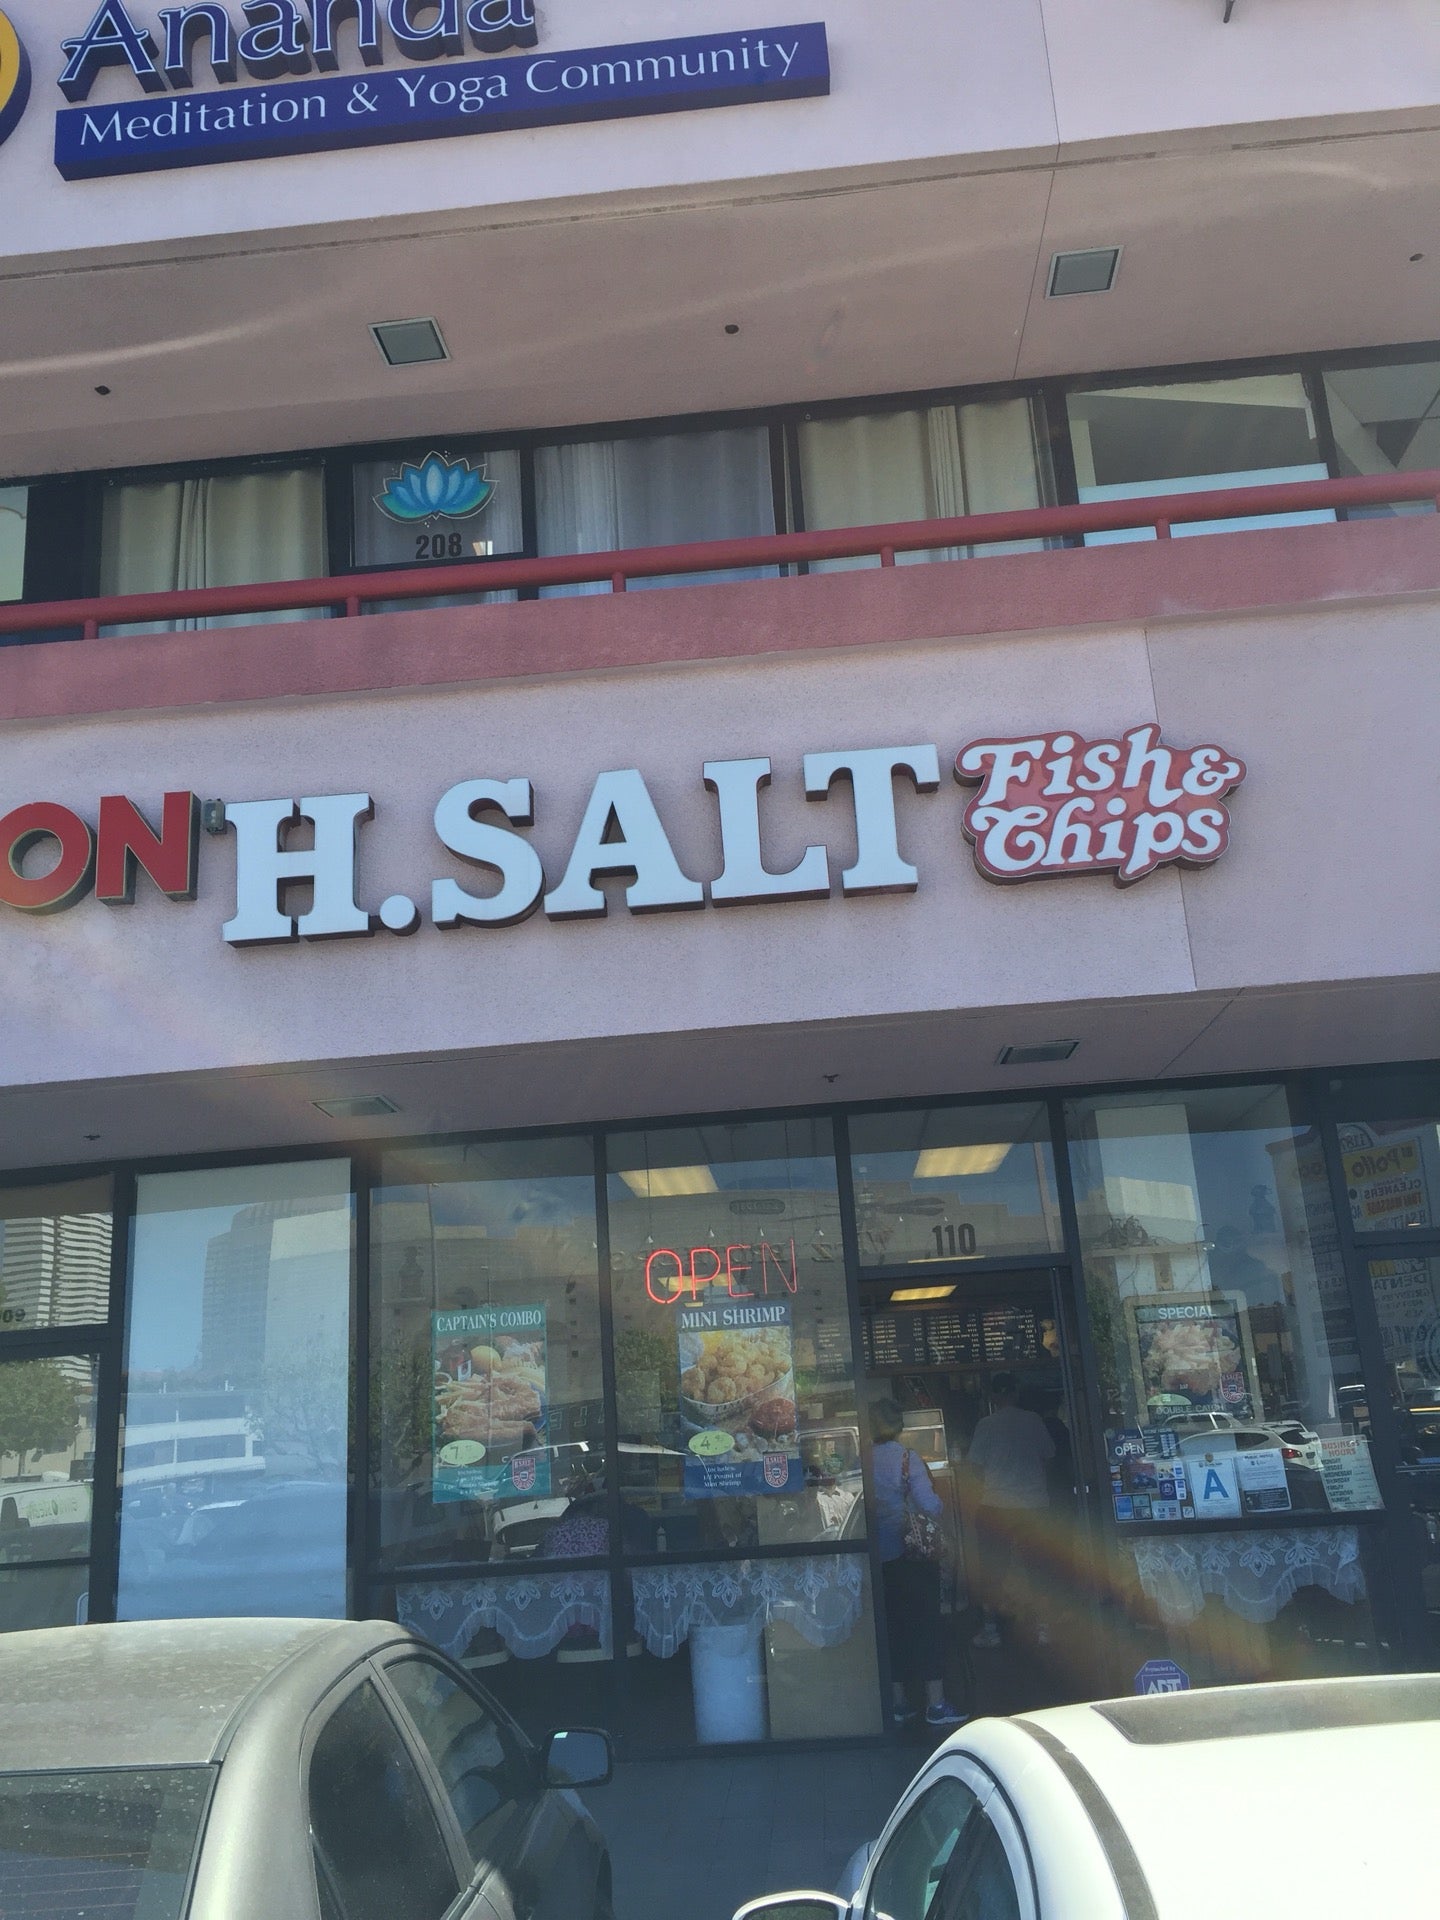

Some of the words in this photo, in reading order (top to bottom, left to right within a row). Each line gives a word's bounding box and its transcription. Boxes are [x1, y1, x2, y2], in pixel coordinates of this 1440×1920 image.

[58, 0, 536, 84] Ananda
[79, 92, 327, 146] Meditation
[347, 84, 380, 114] &
[396, 70, 510, 112] Yoga
[526, 40, 801, 95] Community
[415, 532, 463, 560] 208
[962, 726, 1179, 808] Fish
[972, 796, 1226, 874] Chips
[931, 1222, 977, 1256] 110
[645, 1238, 798, 1304] OPEN
[436, 1313, 497, 1332] CAPTAIN'S
[500, 1309, 542, 1328] COMBO
[681, 1310, 718, 1329] MINI
[723, 1305, 786, 1326] SHRIMP
[1157, 1304, 1217, 1320] SPECIAL
[1115, 1443, 1145, 1457] OPEN
[1203, 1468, 1230, 1500] A
[1147, 1677, 1182, 1695] ADT
